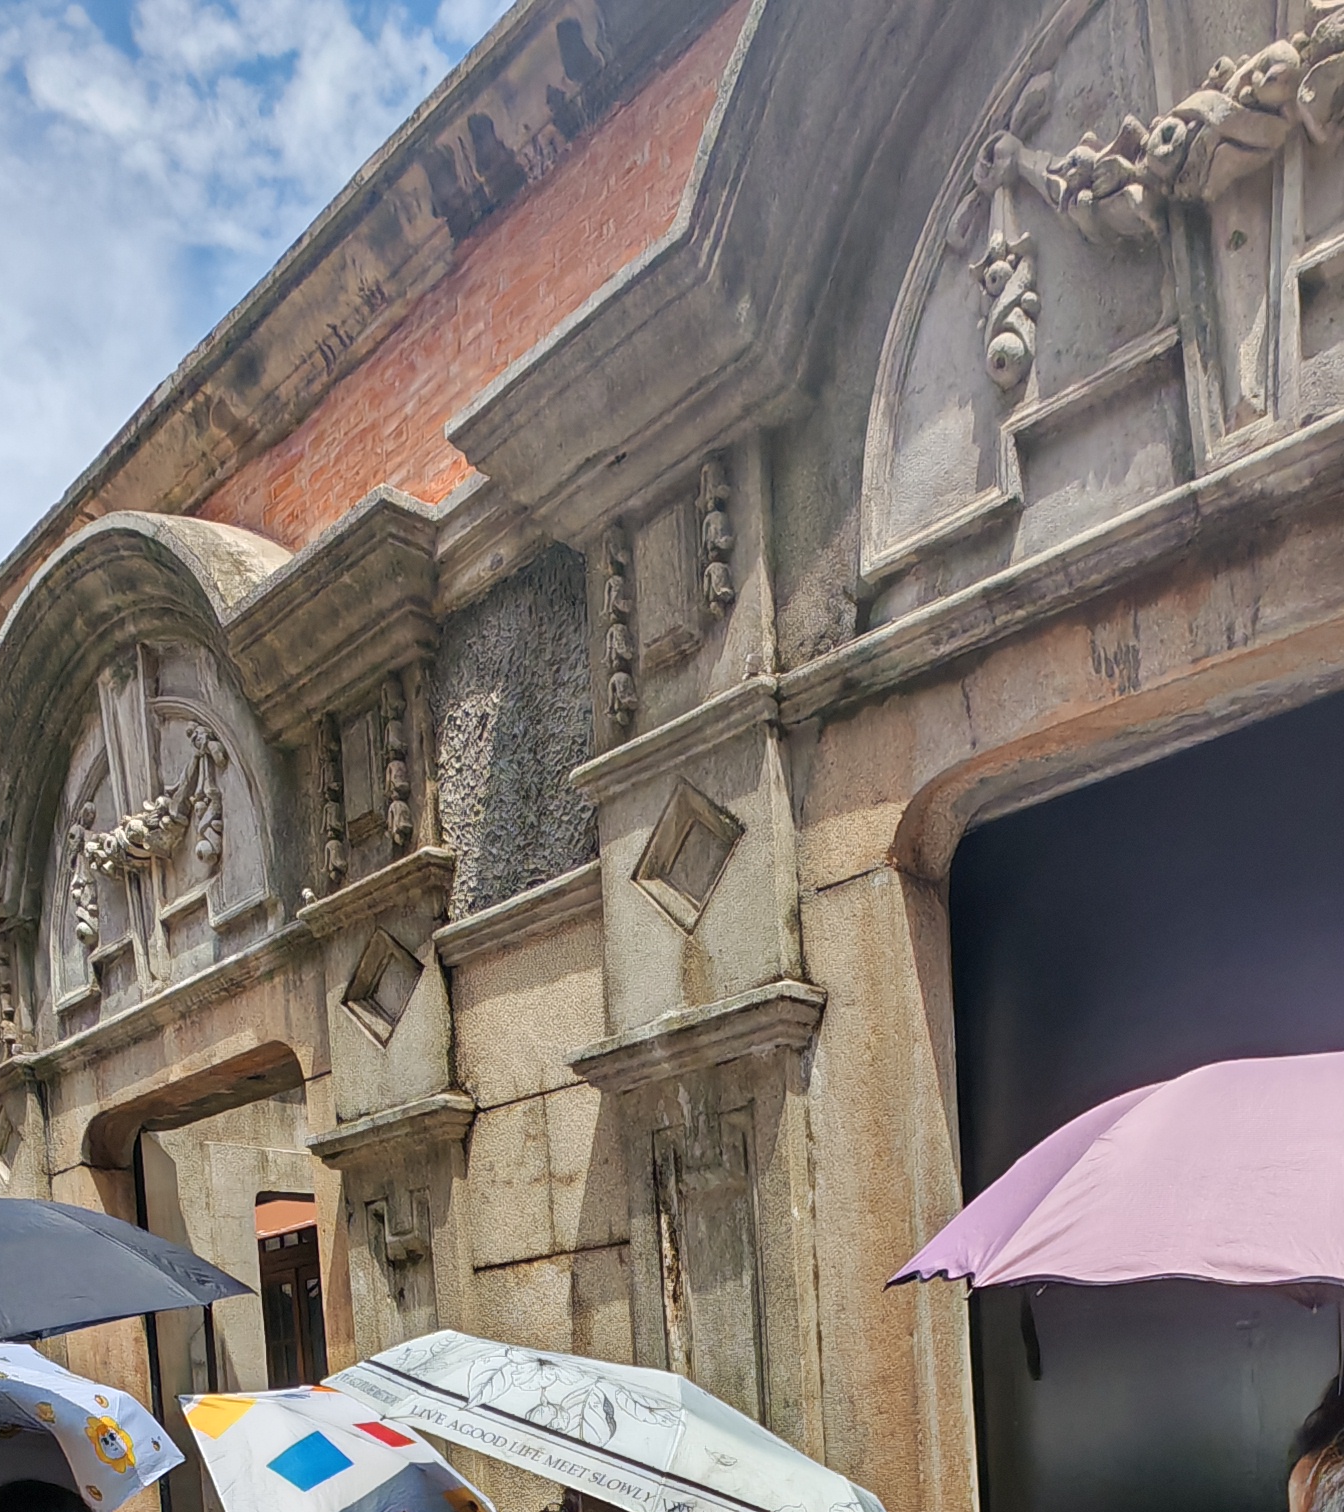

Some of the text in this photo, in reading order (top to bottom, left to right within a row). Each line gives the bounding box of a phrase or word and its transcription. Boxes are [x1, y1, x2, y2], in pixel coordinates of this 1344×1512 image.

[410, 1405, 450, 1426] LIVE
[506, 1441, 545, 1463] LIFE
[543, 1455, 591, 1479] MEET
[588, 1472, 657, 1504] SLOWLY
